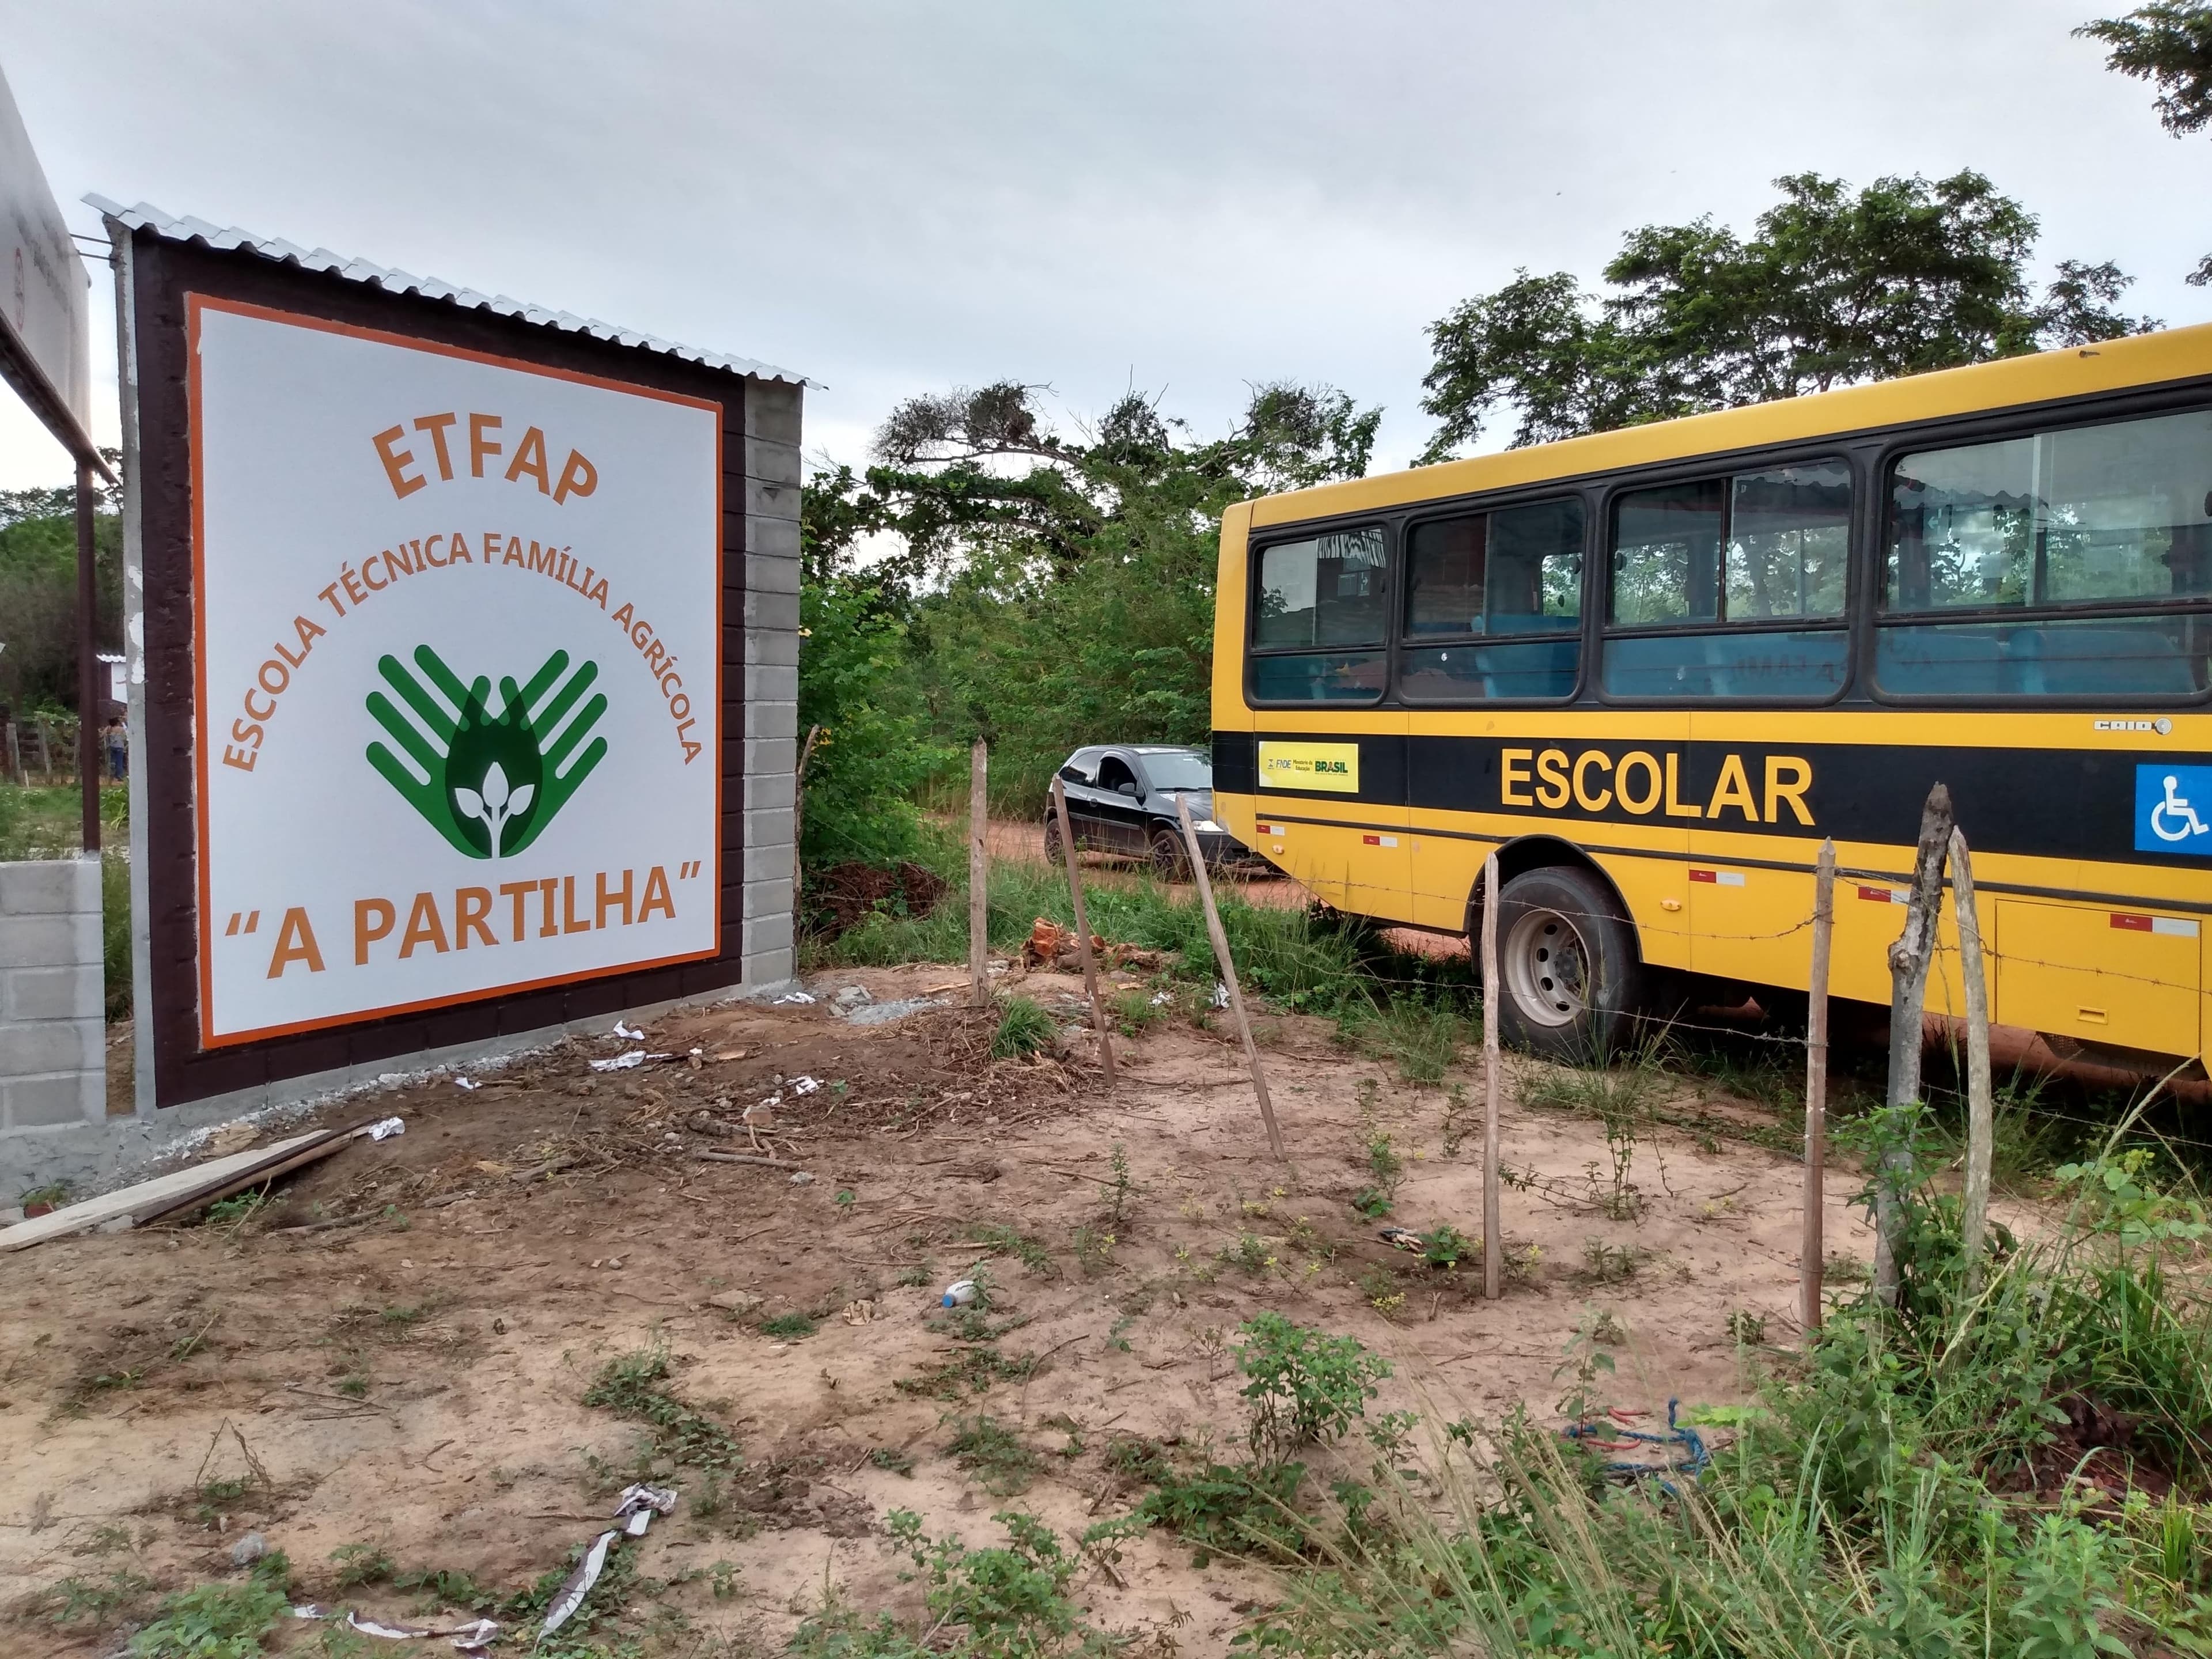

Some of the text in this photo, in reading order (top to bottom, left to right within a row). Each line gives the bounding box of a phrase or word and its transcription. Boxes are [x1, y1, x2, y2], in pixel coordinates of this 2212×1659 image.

[372, 412, 598, 505] ETFAP
[222, 532, 703, 772] ESCOLA TÉCNICA FAMÍLIA AGRÍCOLA
[2093, 720, 2153, 731] CAIO
[1315, 760, 1348, 773] BRASIL
[1501, 748, 1816, 827] ESCOLAR
